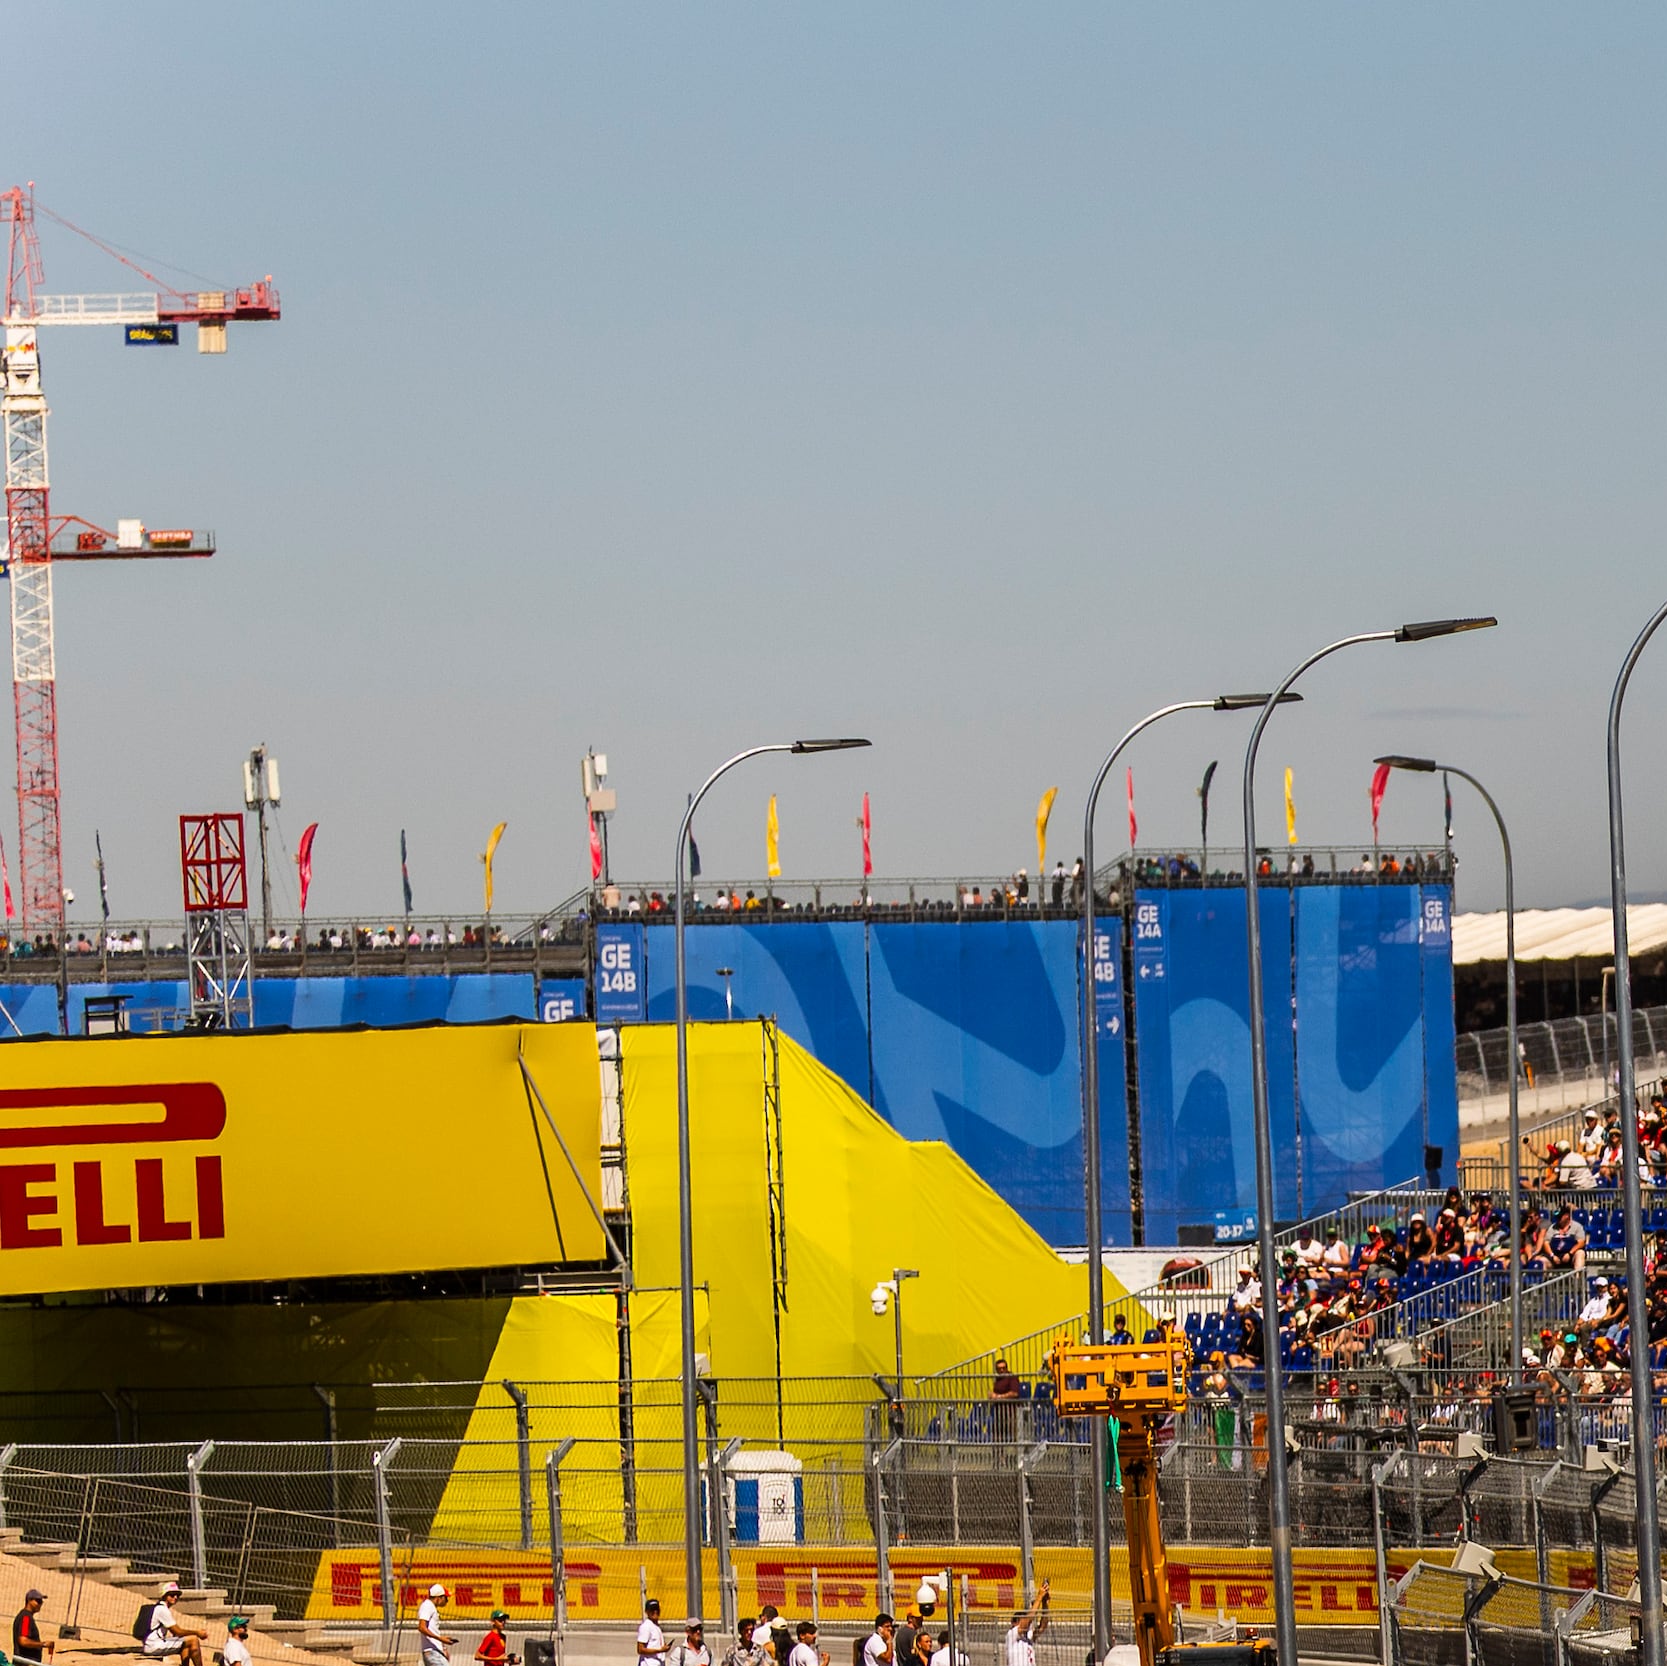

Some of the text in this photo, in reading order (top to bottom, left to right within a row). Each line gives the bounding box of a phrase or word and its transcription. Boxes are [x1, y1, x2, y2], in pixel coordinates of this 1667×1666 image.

[1137, 905, 1159, 923] GE
[1425, 901, 1443, 918] GE
[1137, 924, 1161, 938] 14A
[1425, 919, 1445, 933] 14A
[601, 943, 631, 969] GE
[601, 972, 636, 993] 14B
[544, 1000, 574, 1022] GE
[756, 1562, 1017, 1608] PIRELI
[1168, 1562, 1409, 1611] PIRELL
